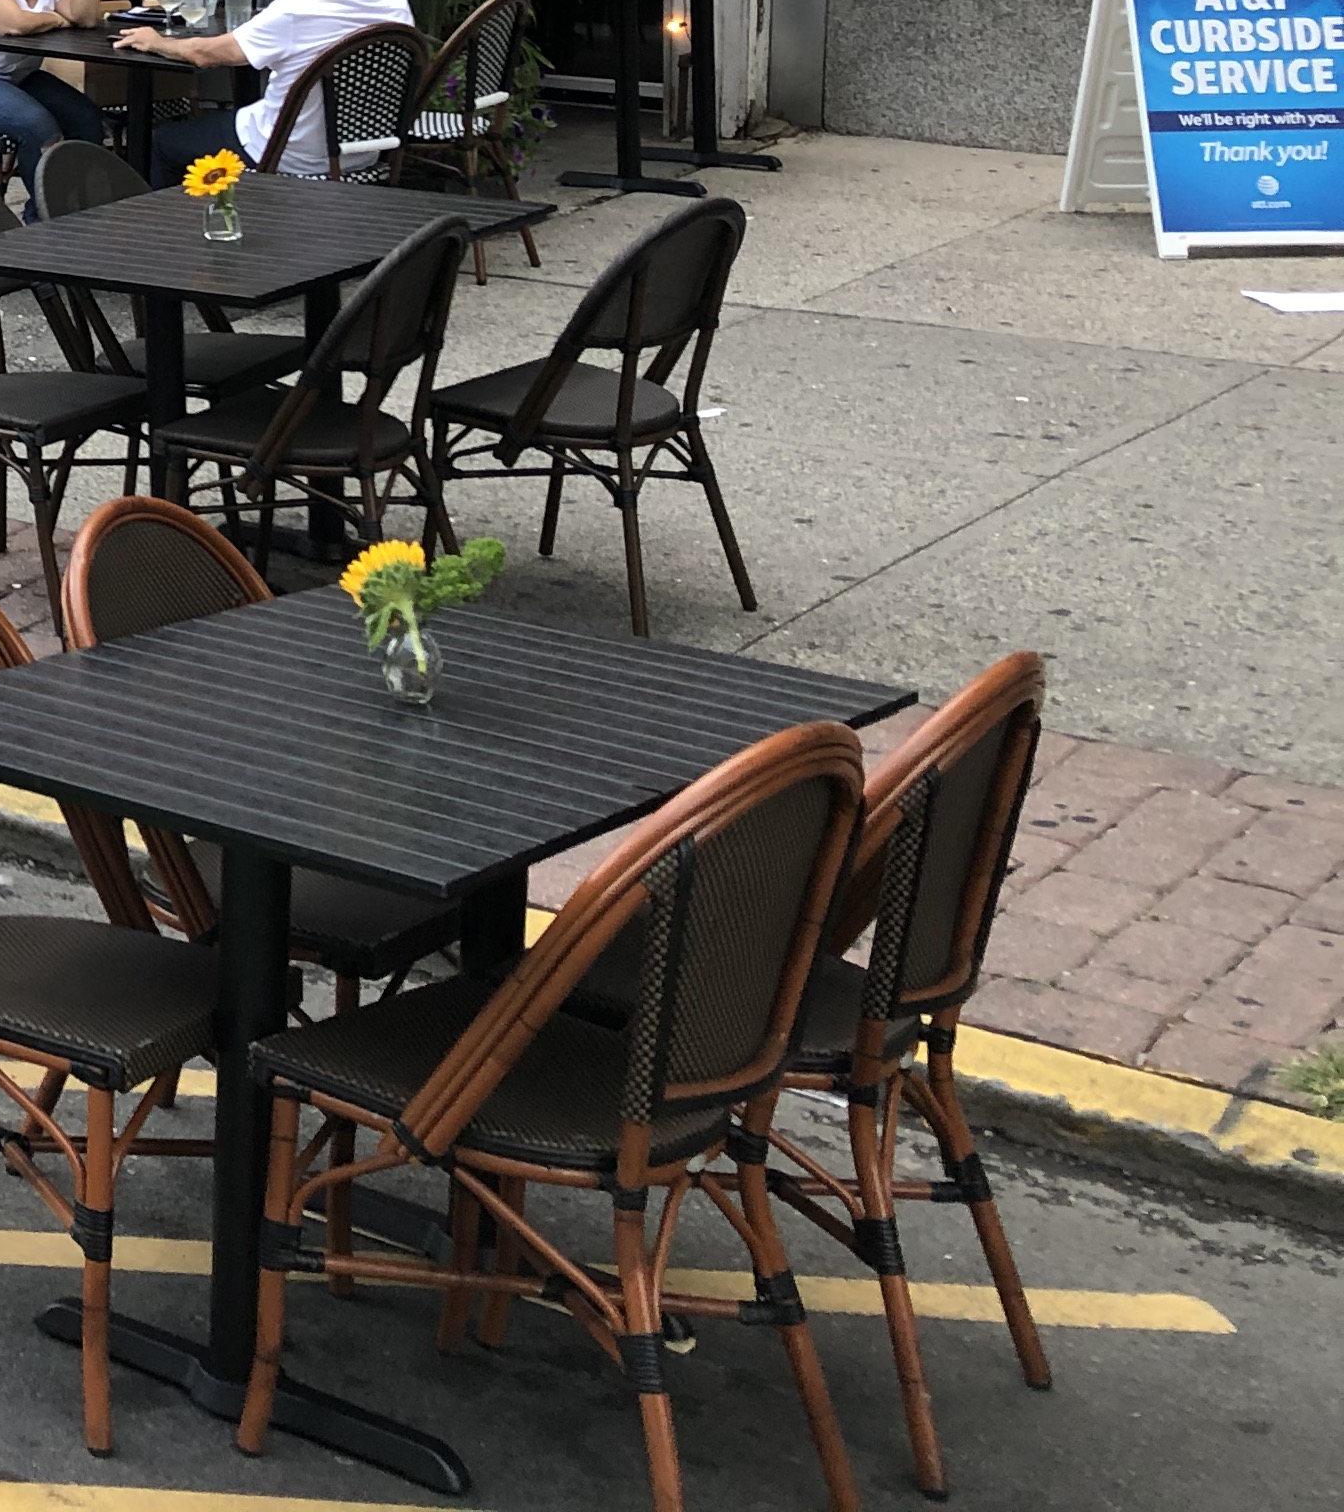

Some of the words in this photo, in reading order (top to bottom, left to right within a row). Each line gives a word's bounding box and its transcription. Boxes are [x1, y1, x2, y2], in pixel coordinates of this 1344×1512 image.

[1150, 16, 1344, 54] CURBSIDE
[1170, 58, 1338, 96] SERVICE
[1177, 112, 1212, 127] We'll
[1214, 113, 1234, 126] be
[1235, 112, 1272, 129] right
[1272, 111, 1306, 125] with
[1307, 113, 1340, 128] you.
[1199, 140, 1274, 162] Thank
[1275, 140, 1329, 167] you!
